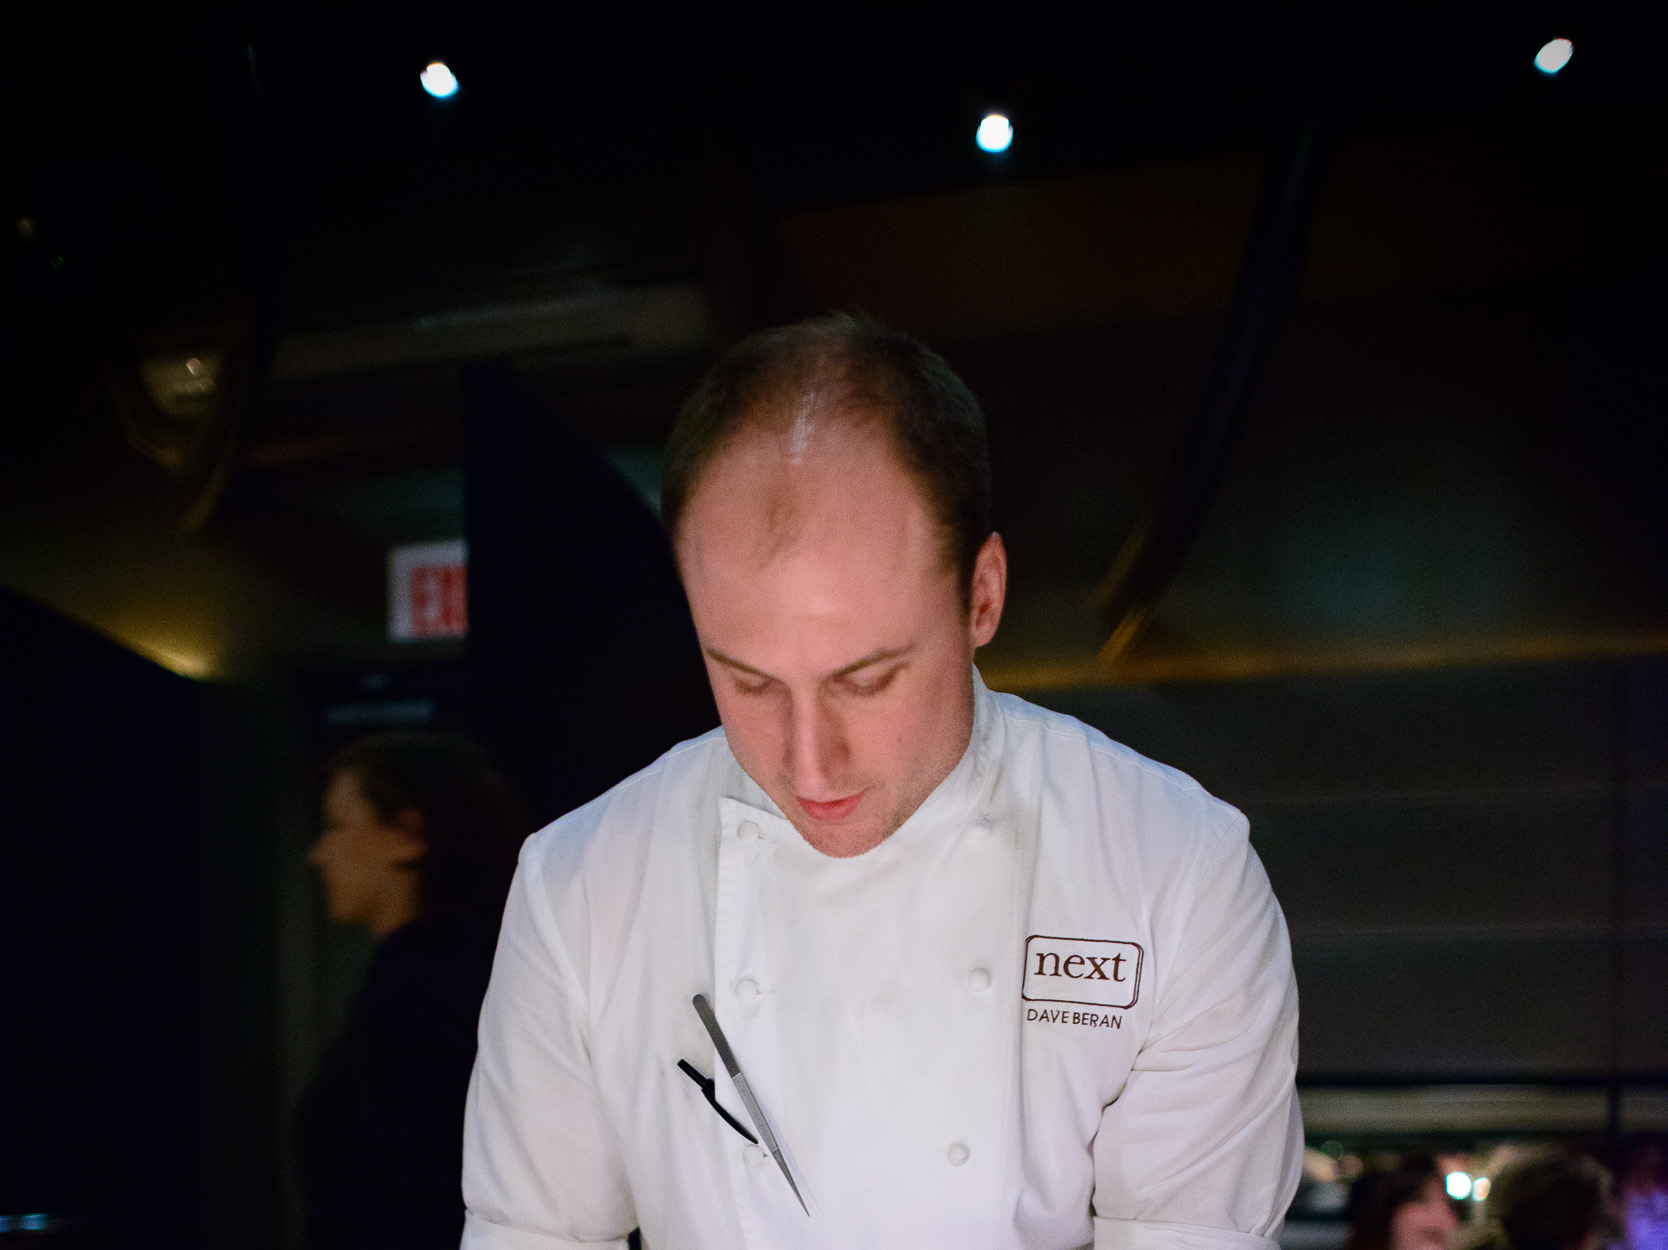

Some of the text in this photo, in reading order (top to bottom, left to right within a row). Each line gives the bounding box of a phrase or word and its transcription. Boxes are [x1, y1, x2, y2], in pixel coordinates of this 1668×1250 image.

[1034, 952, 1127, 982] next
[1026, 1008, 1123, 1030] DAVE BERAN
